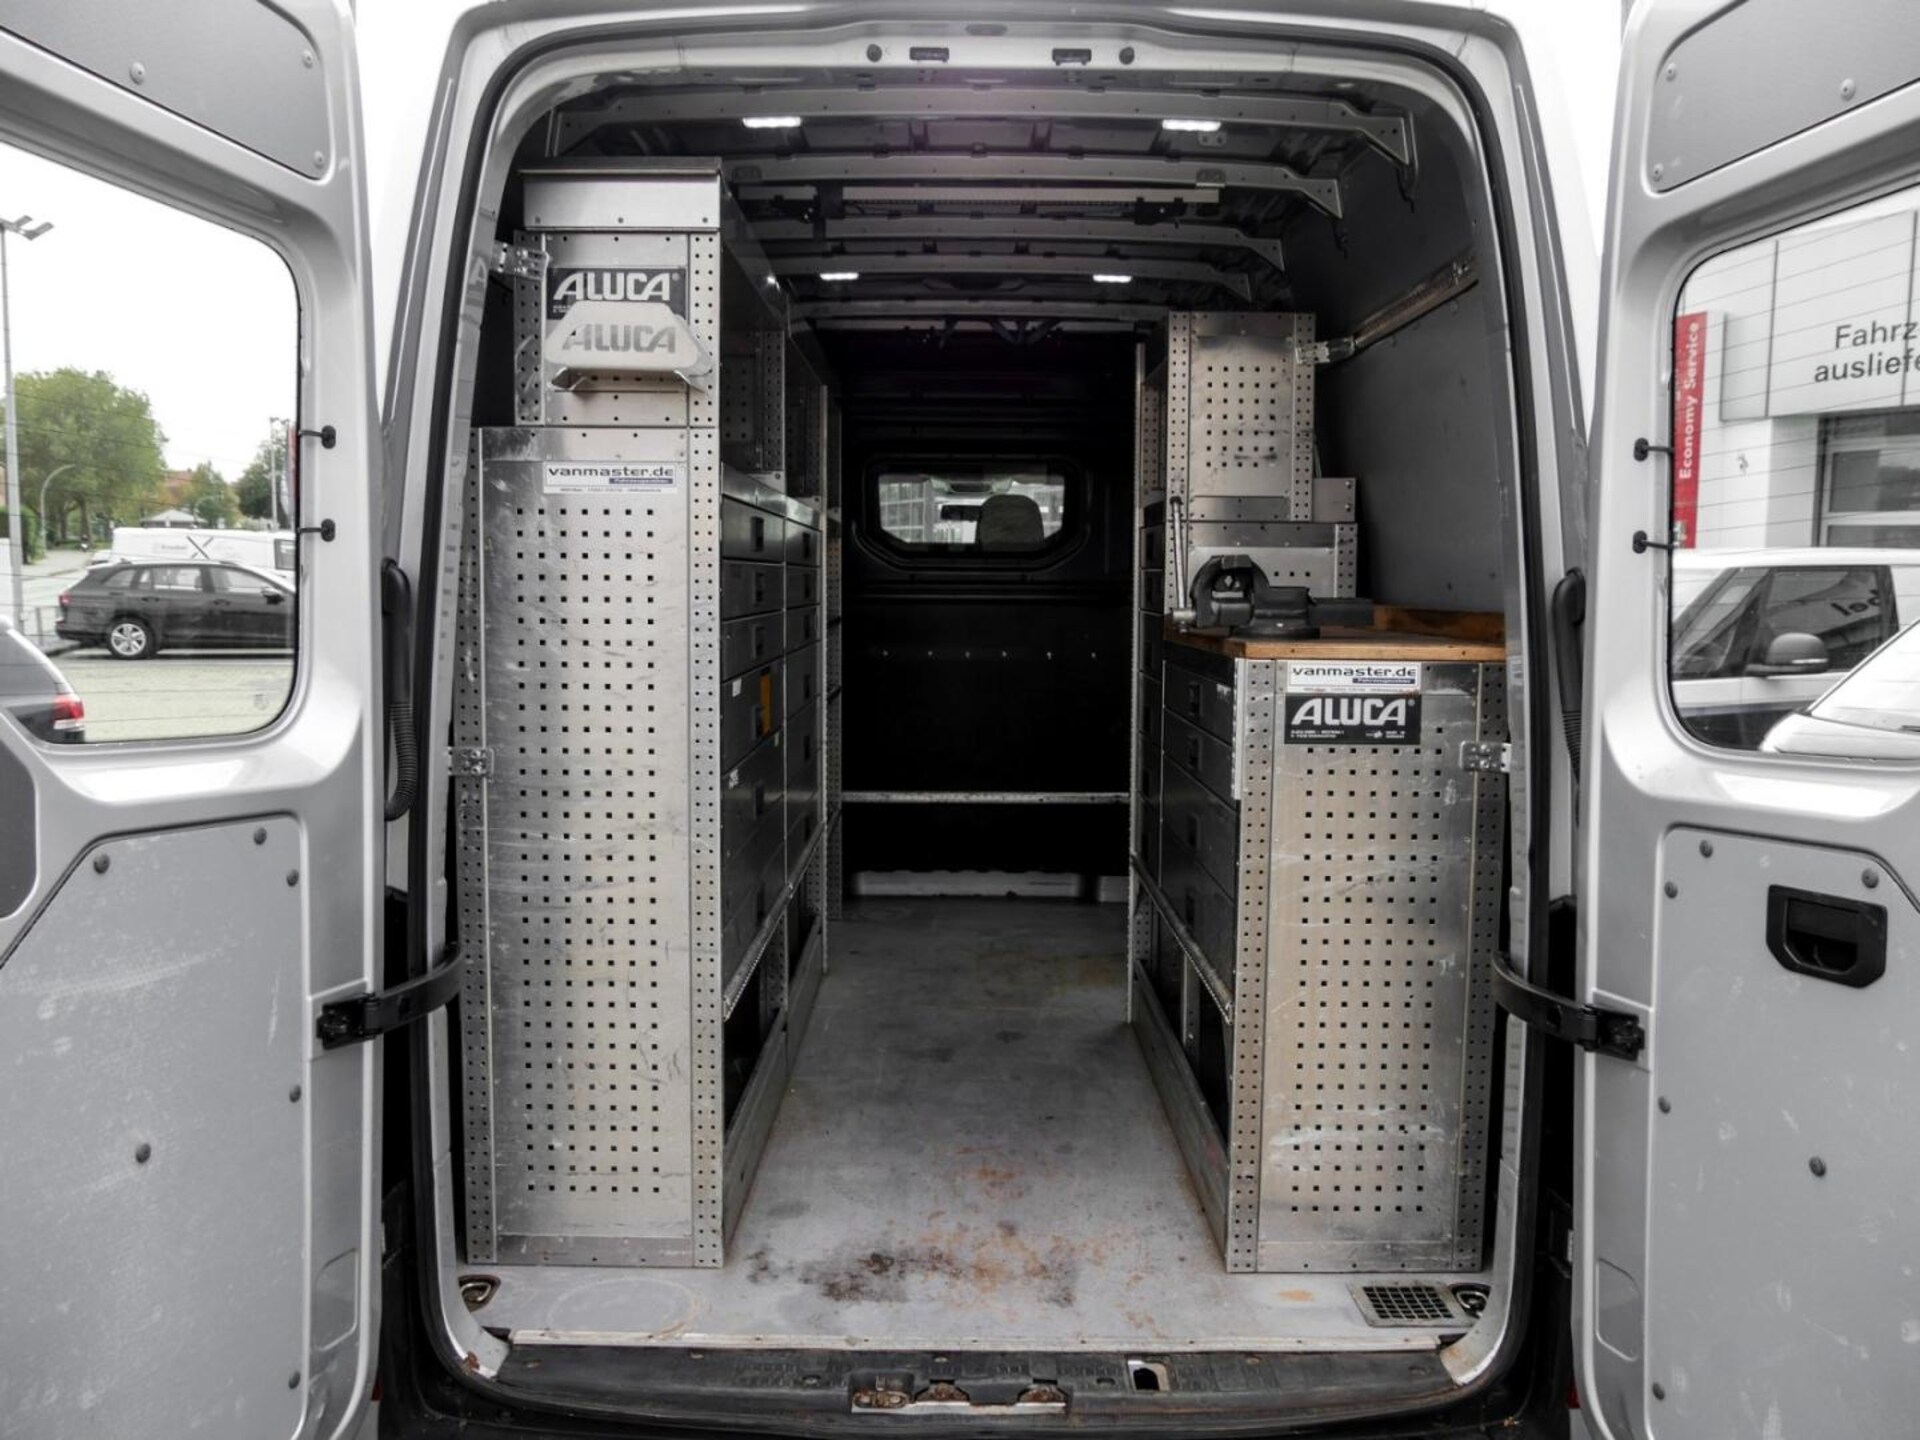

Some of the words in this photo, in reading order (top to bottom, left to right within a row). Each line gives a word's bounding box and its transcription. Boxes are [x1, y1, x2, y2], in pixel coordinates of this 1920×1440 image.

[553, 272, 671, 300] ALUCA
[562, 324, 677, 354] ALUCA
[1684, 322, 1699, 389] Service
[1678, 395, 1698, 479] Economy
[548, 466, 674, 477] vanmaster.de
[1292, 666, 1417, 677] vanmaster.de
[1291, 698, 1406, 726] ALUCA
